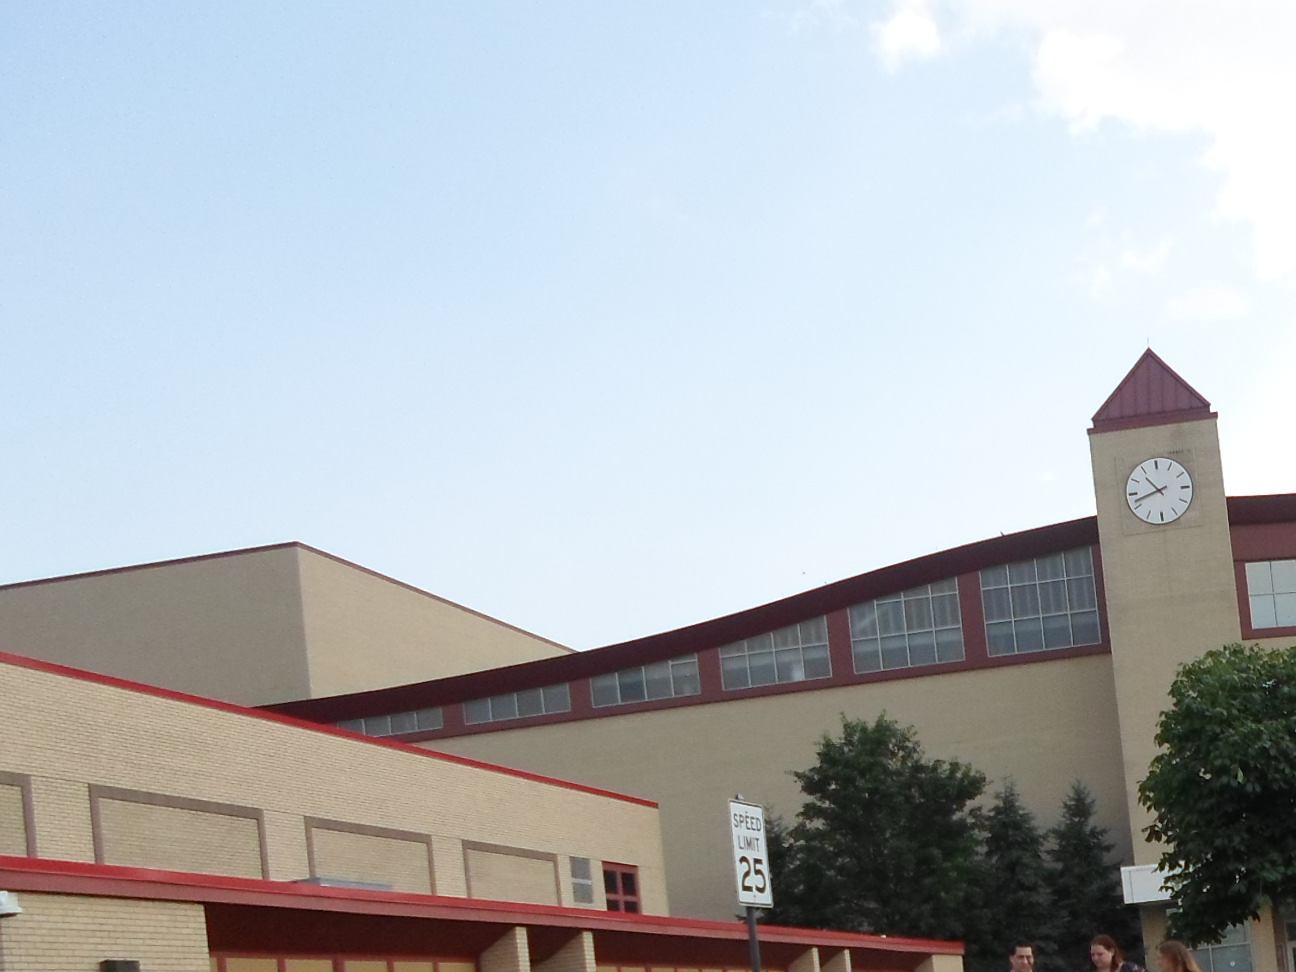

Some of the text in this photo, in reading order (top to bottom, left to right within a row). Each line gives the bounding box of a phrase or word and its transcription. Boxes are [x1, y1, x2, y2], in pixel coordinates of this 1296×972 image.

[733, 813, 762, 831] SPEED
[738, 835, 760, 852] LIMIT
[739, 856, 766, 893] 25
